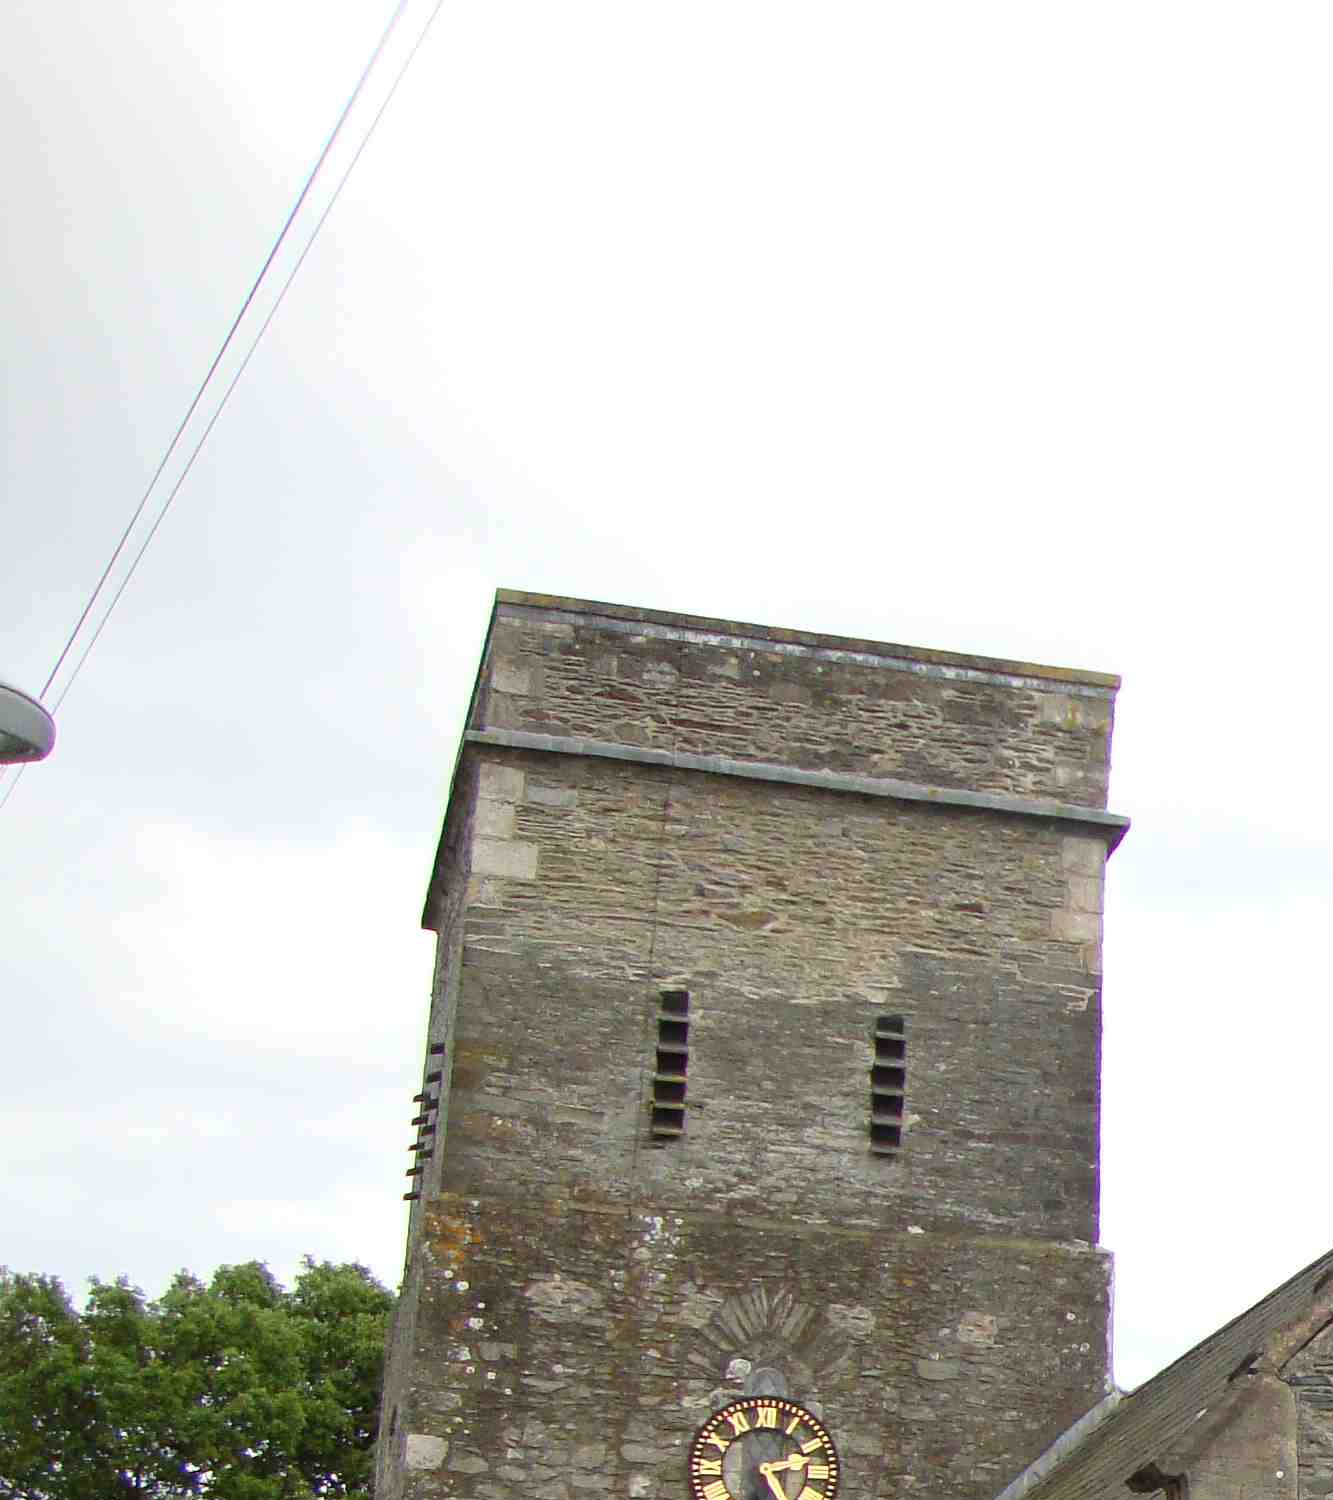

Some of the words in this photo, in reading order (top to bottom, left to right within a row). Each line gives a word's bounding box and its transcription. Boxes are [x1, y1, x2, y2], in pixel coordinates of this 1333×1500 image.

[755, 1407, 777, 1428] XII
[706, 1432, 730, 1453] X
[801, 1437, 823, 1454] II
[807, 1465, 829, 1479] III
